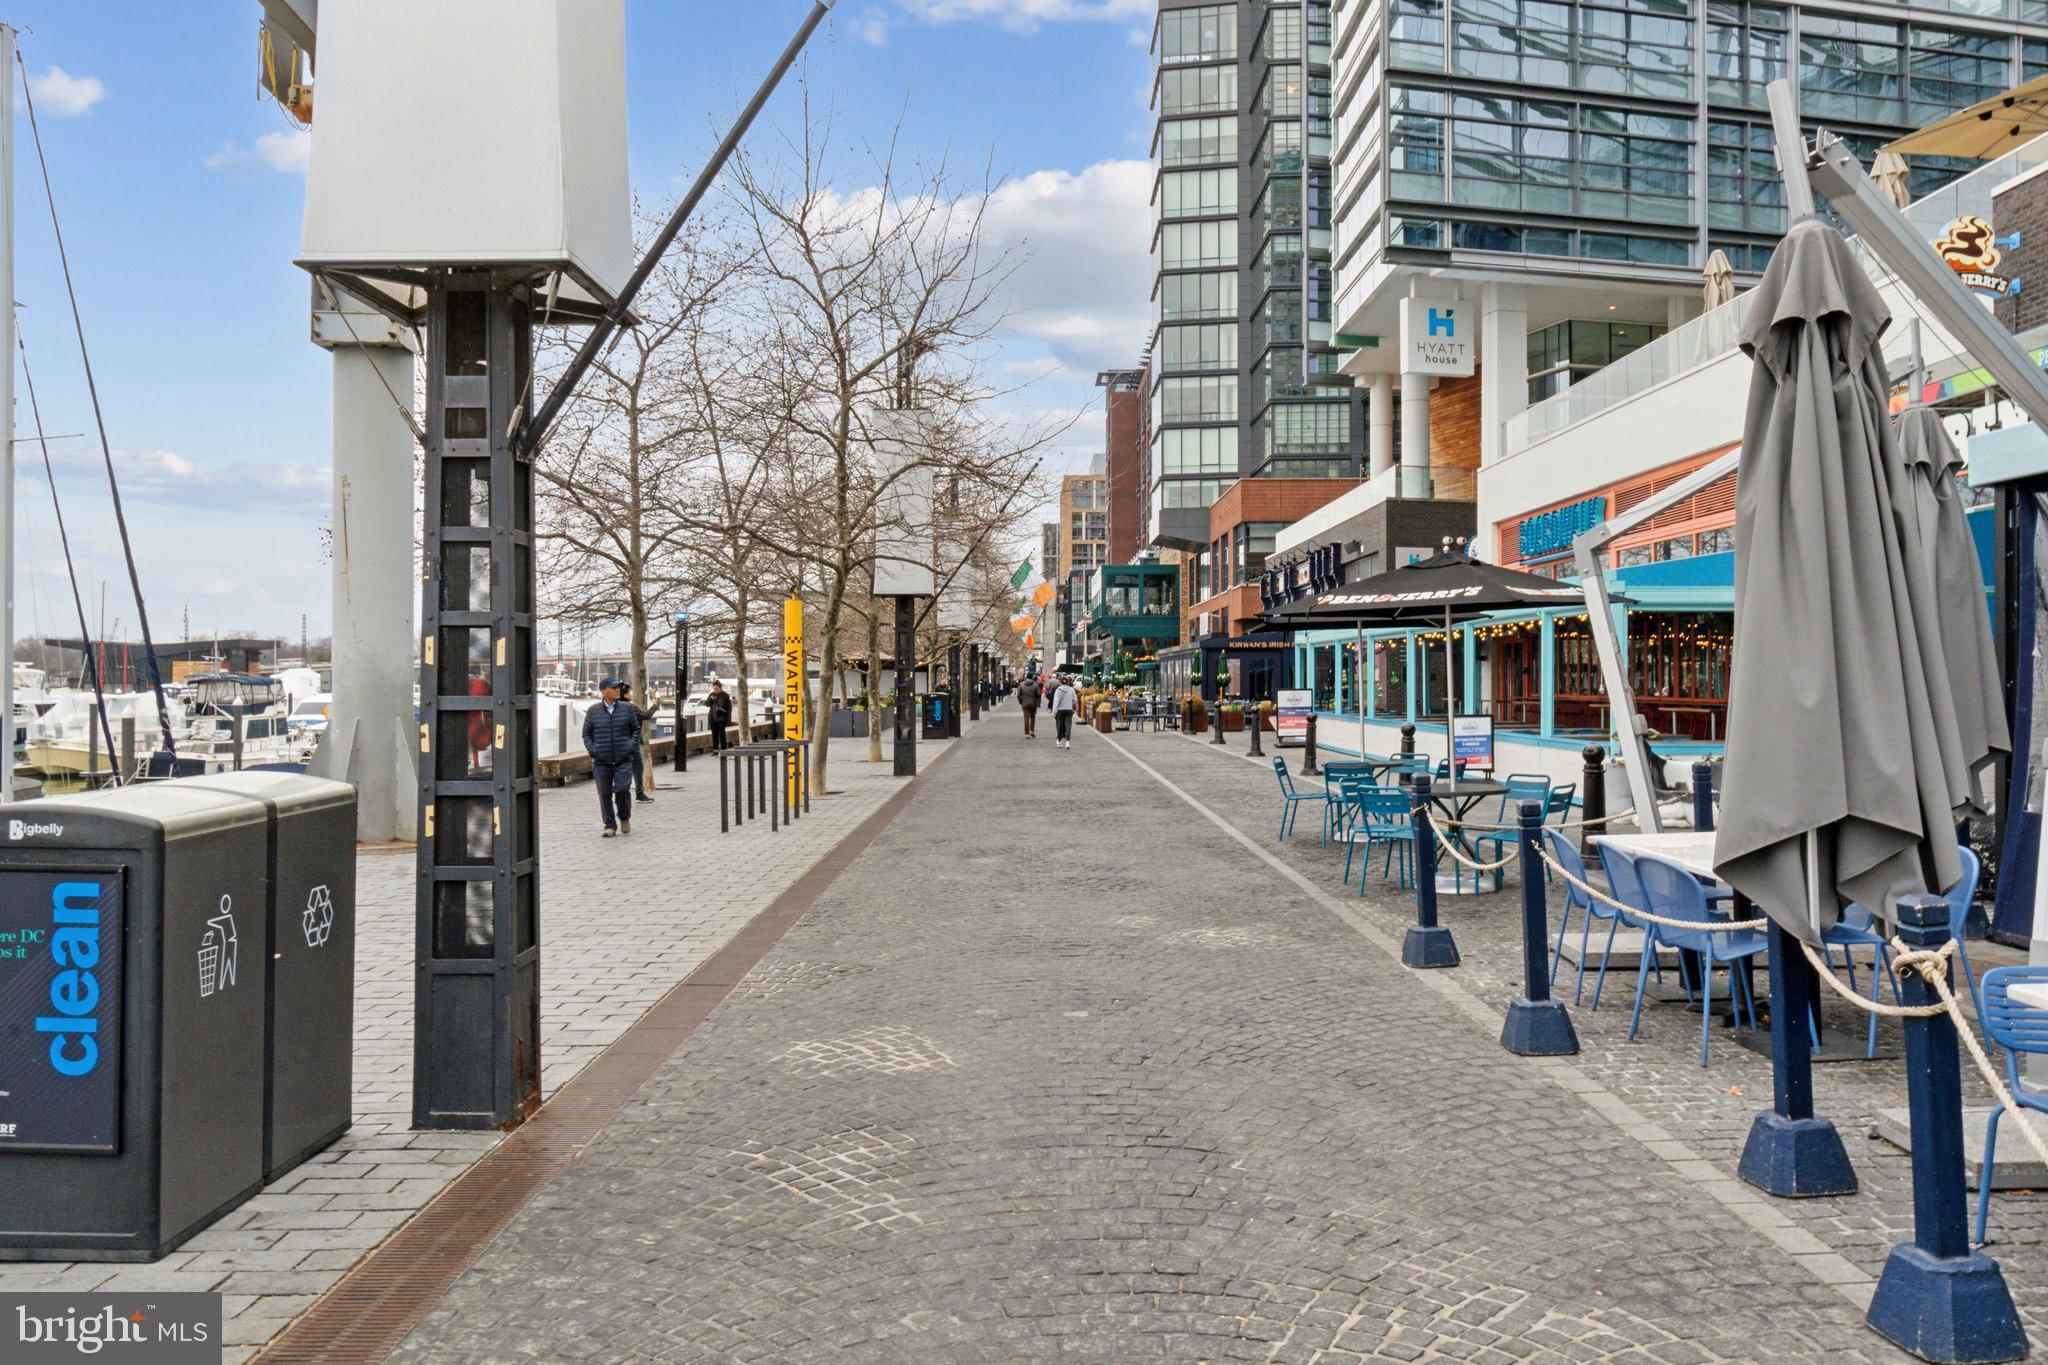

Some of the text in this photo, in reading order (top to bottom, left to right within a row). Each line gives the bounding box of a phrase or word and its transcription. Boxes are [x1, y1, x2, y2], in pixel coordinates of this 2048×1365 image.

[1417, 342, 1465, 355] HYATT
[1425, 354, 1458, 365] house
[677, 629, 686, 670] Emergency
[786, 650, 798, 714] WATER
[9, 820, 64, 840] Bigbelly
[20, 929, 46, 944] DC
[16, 945, 27, 959] it
[35, 882, 100, 1076] clean
